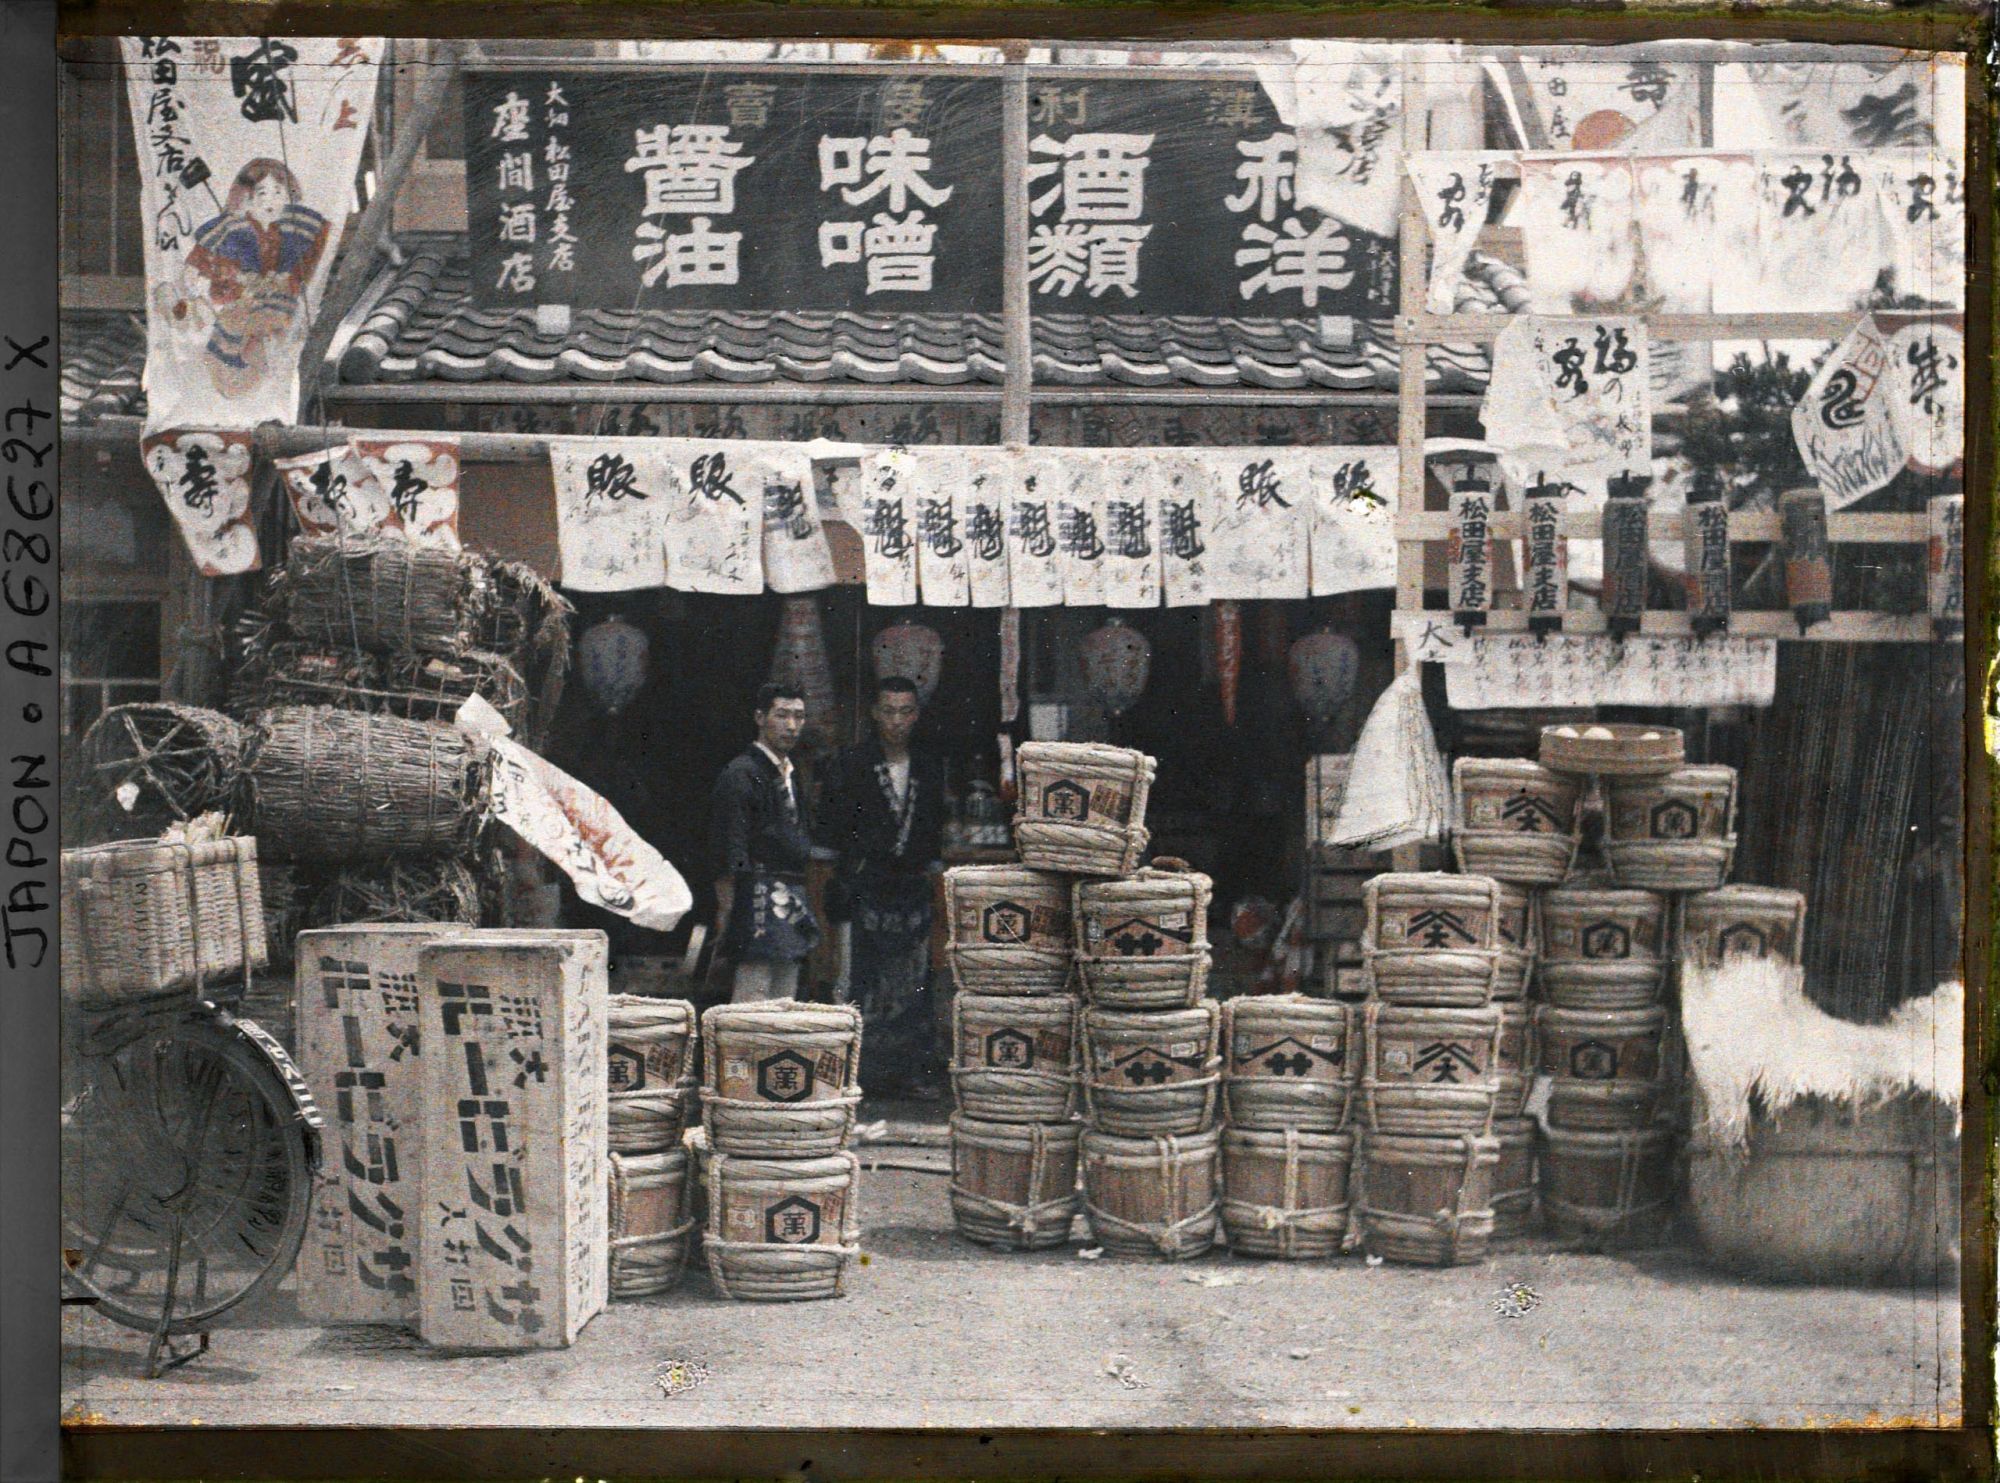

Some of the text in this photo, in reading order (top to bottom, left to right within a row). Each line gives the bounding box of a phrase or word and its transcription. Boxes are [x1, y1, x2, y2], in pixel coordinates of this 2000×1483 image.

[1224, 132, 1354, 308] 和洋
[1457, 496, 1491, 608] 松田屋支店
[1529, 501, 1559, 611] 松田屋支店
